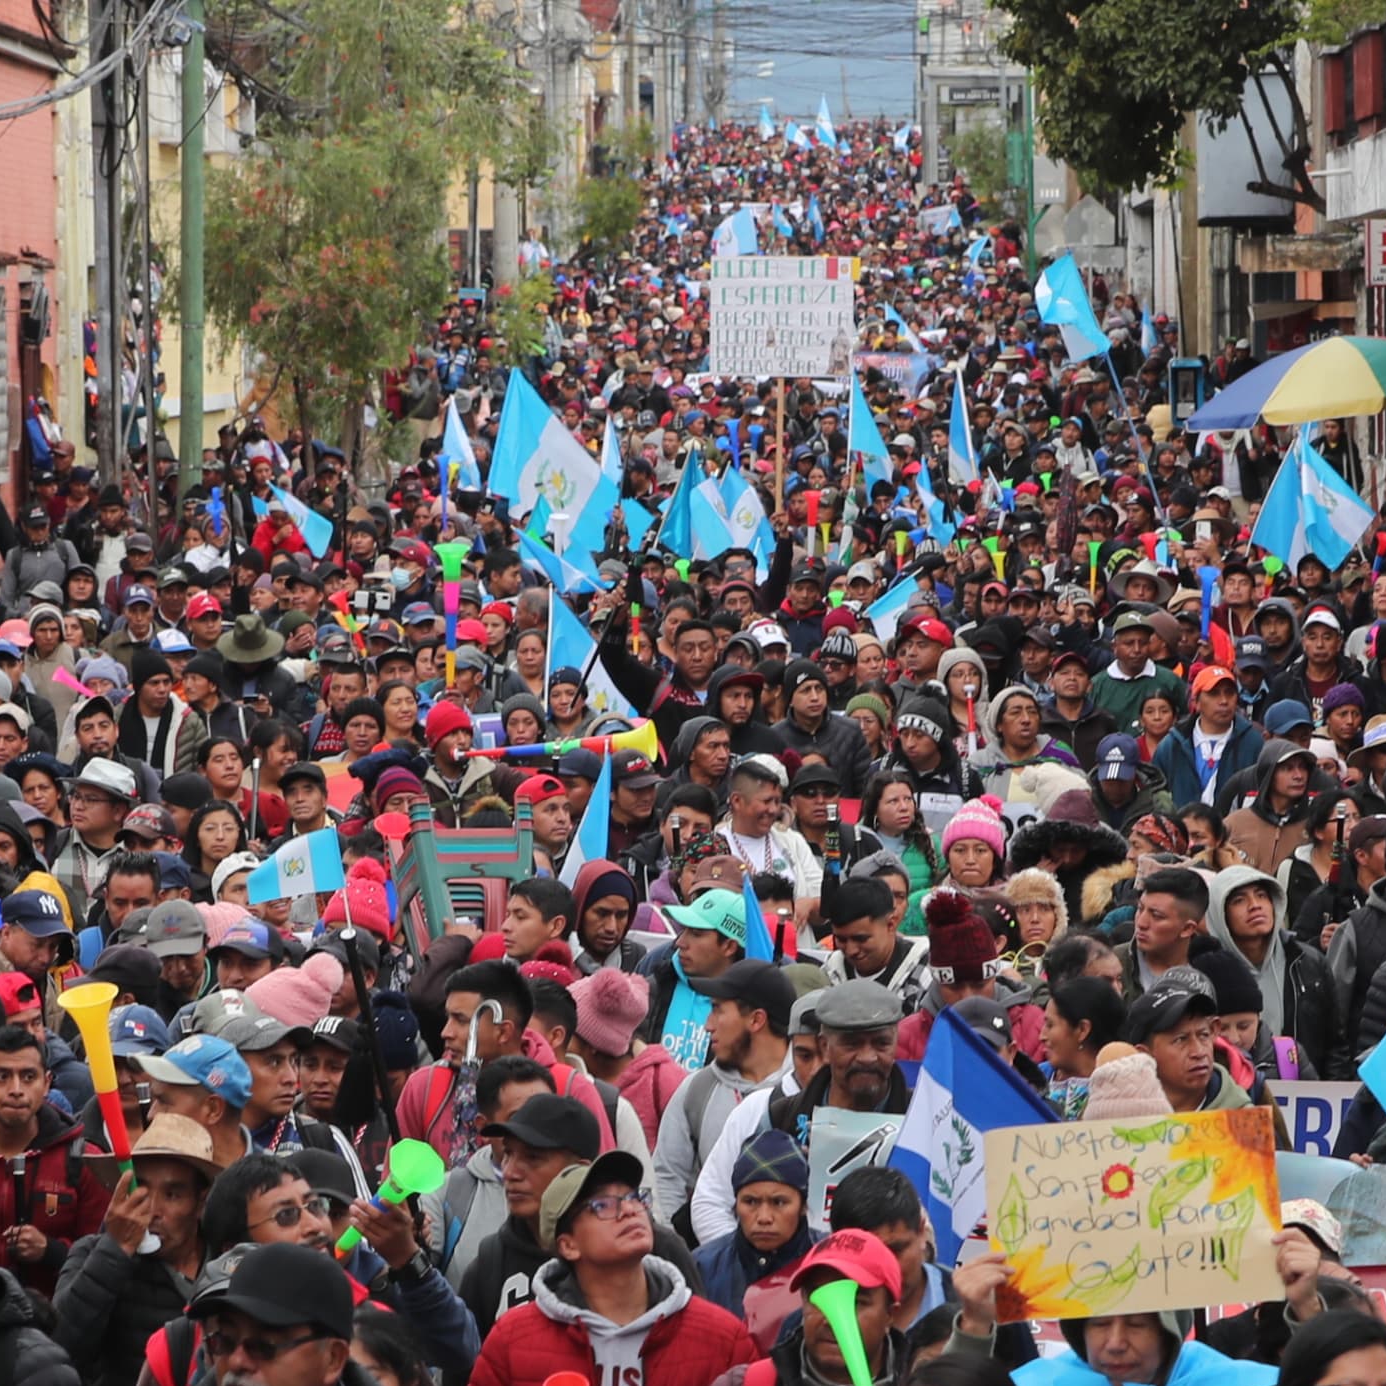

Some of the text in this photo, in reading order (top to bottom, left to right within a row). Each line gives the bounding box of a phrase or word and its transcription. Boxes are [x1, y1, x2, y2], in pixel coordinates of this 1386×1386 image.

[898, 713, 941, 743] NIKE
[720, 914, 747, 942] Ferra
[1012, 1126, 1147, 1163] Nuestras
